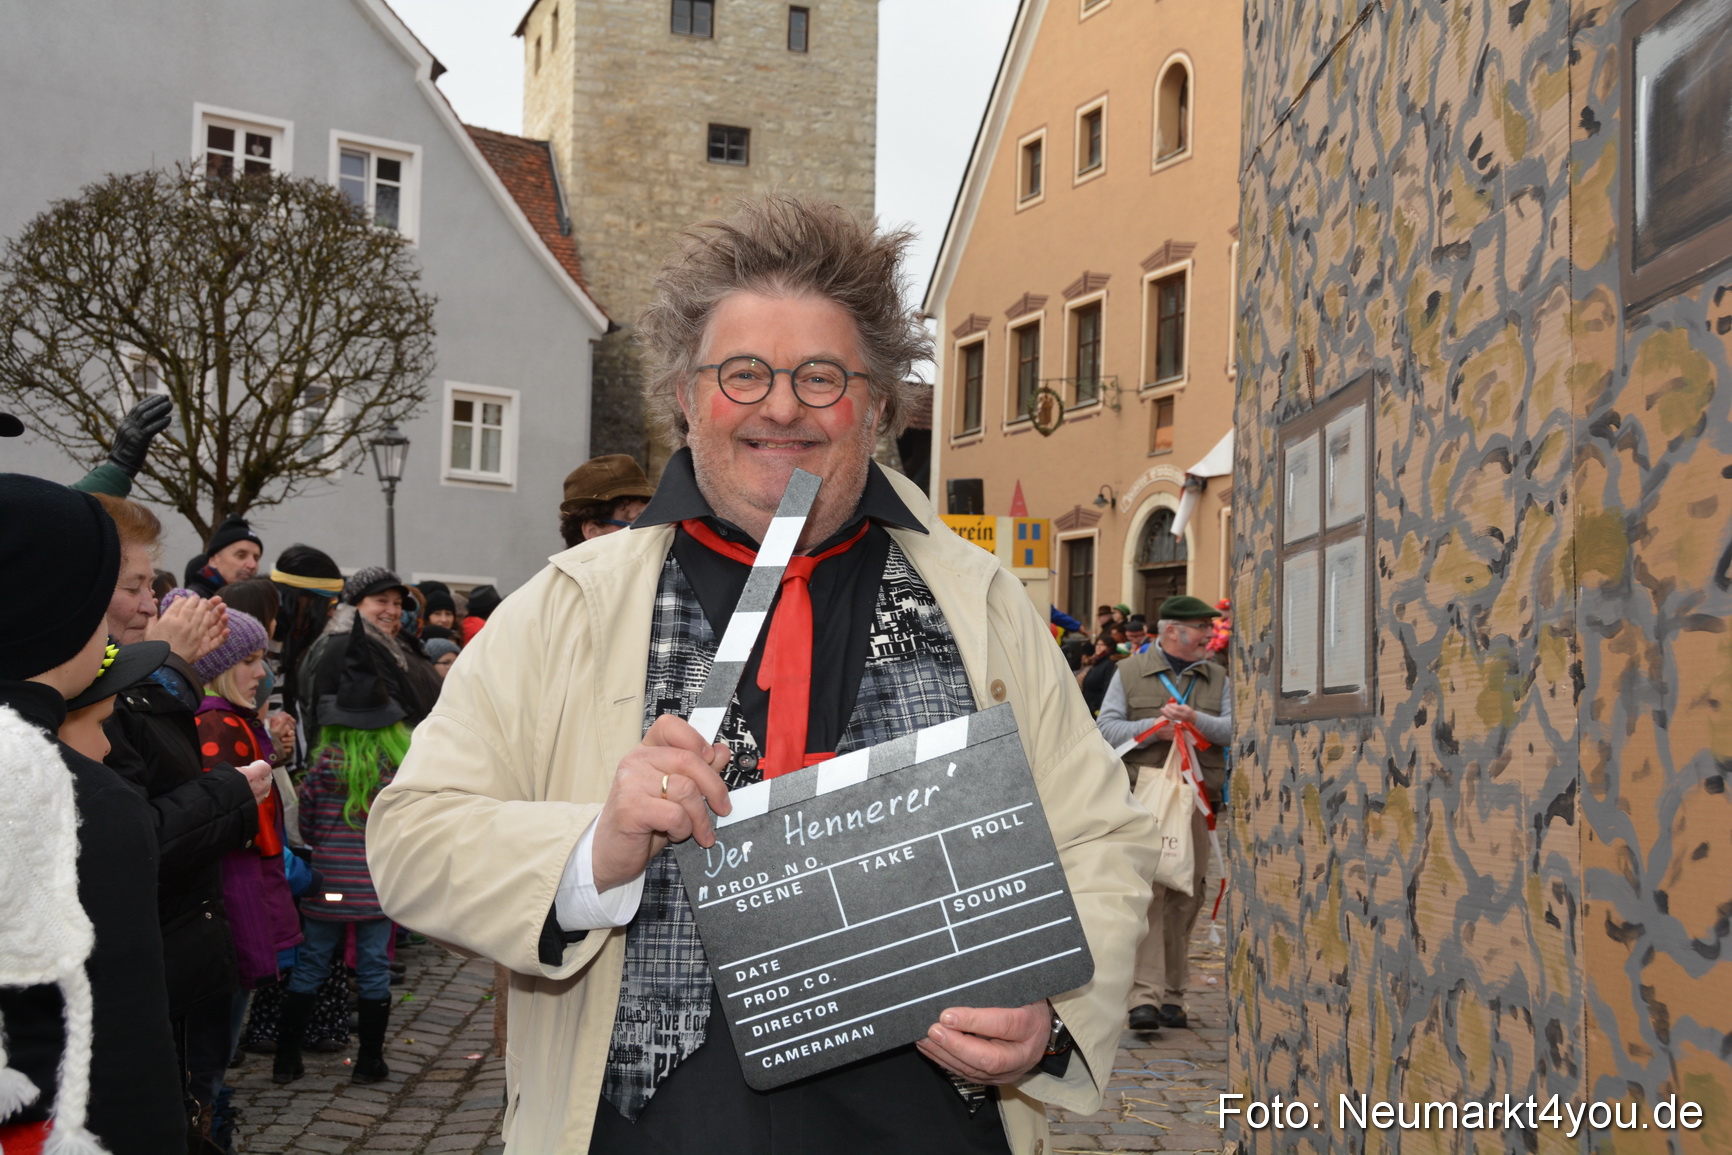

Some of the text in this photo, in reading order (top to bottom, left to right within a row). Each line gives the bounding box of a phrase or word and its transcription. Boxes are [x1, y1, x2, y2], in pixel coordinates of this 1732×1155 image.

[971, 813, 1024, 839] ROLL
[858, 846, 915, 873] TAKE
[716, 872, 759, 897] PROD
[735, 881, 803, 913] SCENE
[952, 879, 1028, 912] SOUND
[735, 959, 781, 983] DATE
[743, 986, 790, 1009] PROD
[751, 1001, 839, 1038] DIRECTOR
[761, 1023, 875, 1069] CAMERAMAN
